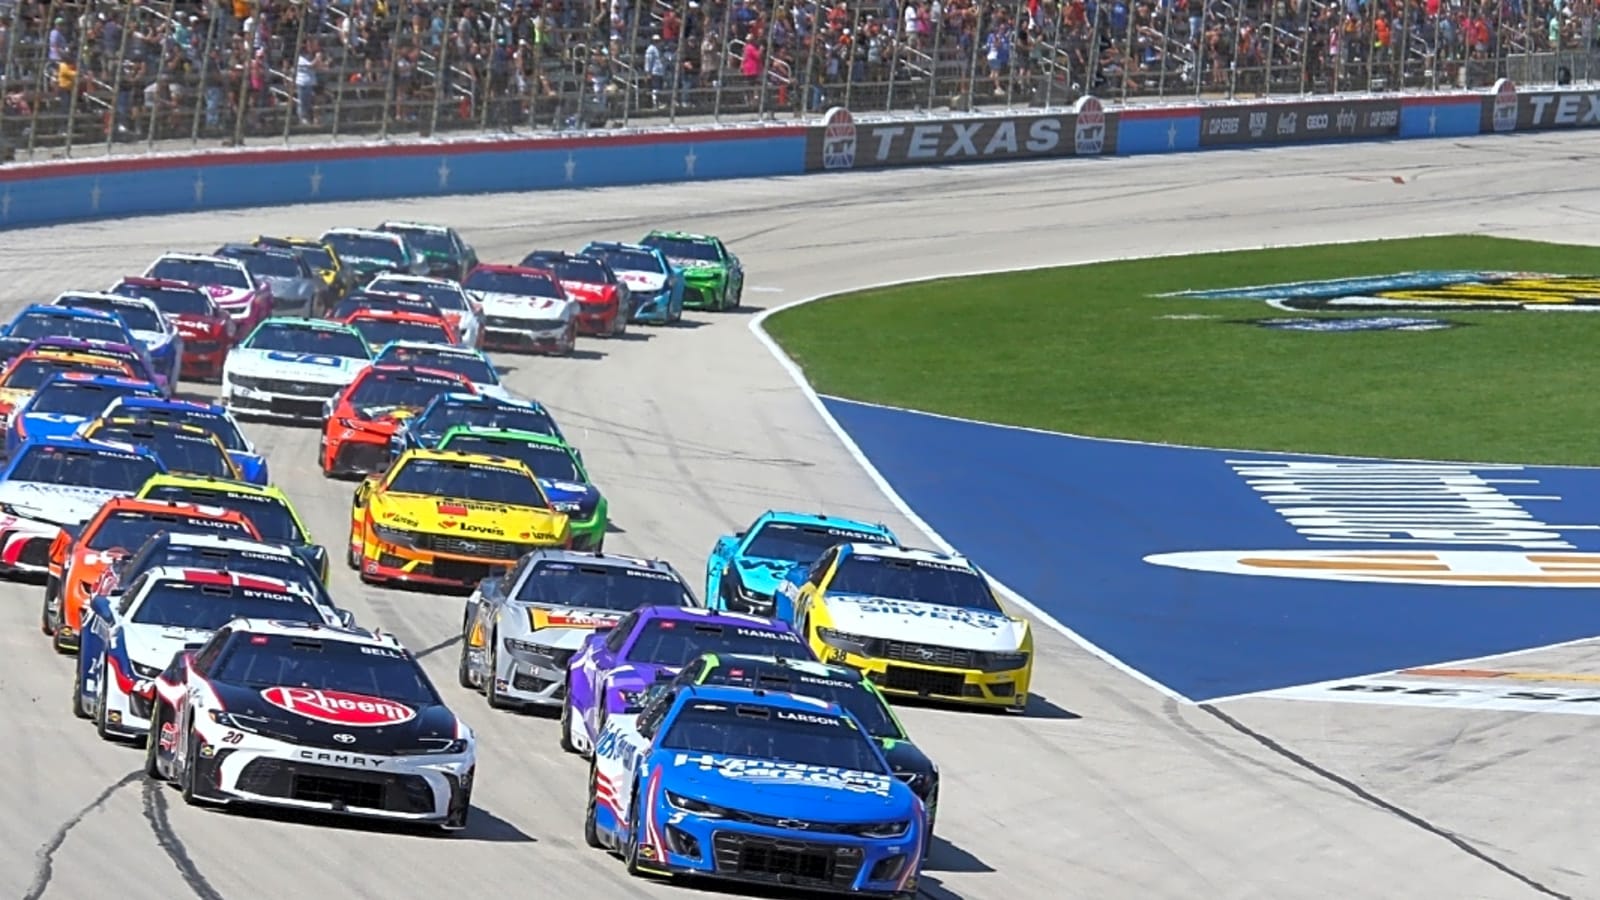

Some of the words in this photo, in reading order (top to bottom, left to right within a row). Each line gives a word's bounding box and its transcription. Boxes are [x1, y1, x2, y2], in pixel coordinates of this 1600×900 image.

[1307, 114, 1328, 129] GEICO
[872, 118, 1061, 161] TEXAS
[98, 450, 143, 462] WALLACE
[227, 491, 272, 504] BLANEY
[187, 518, 240, 531] ELLIOTT
[828, 528, 887, 543] CHASTAIN
[243, 589, 294, 603] BYRON
[737, 628, 795, 642] HAMLIN
[360, 646, 400, 659] BELL
[831, 647, 847, 662] 38
[800, 675, 855, 689] REDDICK
[278, 686, 406, 721] Rheem
[777, 711, 840, 727] LARSON
[221, 730, 245, 745] 20
[300, 750, 386, 767] CAMRY
